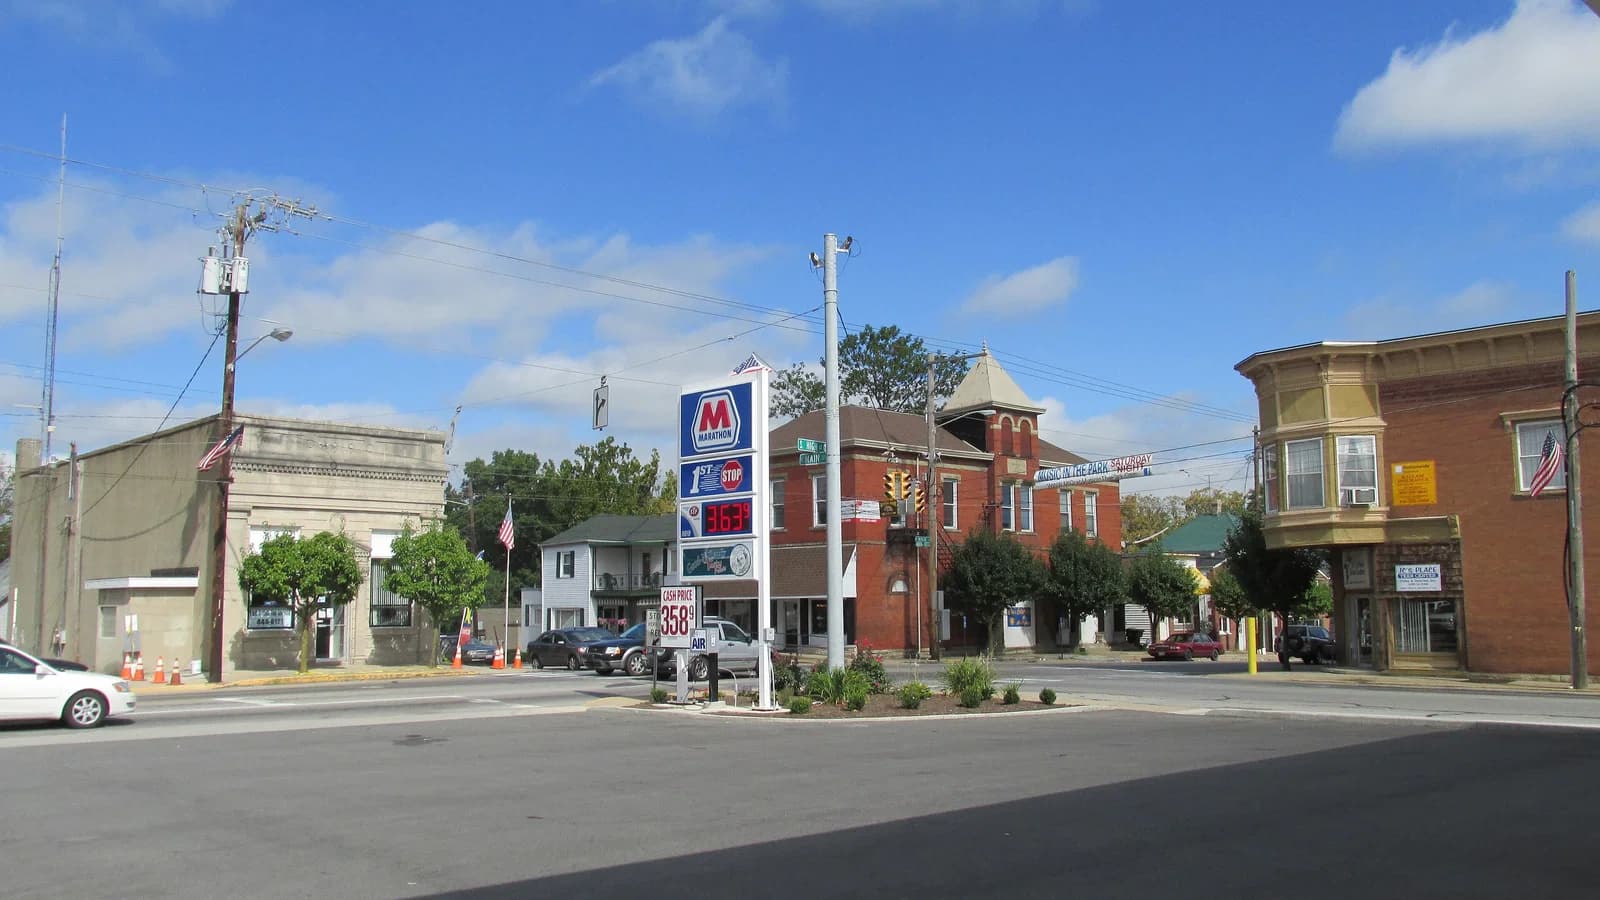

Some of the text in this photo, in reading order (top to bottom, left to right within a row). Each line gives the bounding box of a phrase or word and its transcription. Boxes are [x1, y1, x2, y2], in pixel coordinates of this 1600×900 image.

[699, 399, 731, 432] M
[698, 429, 732, 443] MARATHON
[1037, 468, 1062, 482] MUSIC
[1062, 465, 1072, 478] IN
[1073, 464, 1087, 477] THE
[1088, 461, 1109, 475] PARK
[1110, 454, 1152, 469] SATURDAY
[721, 468, 742, 483] STOP
[663, 589, 693, 601] CASH PRICE
[692, 637, 706, 650] AIR
